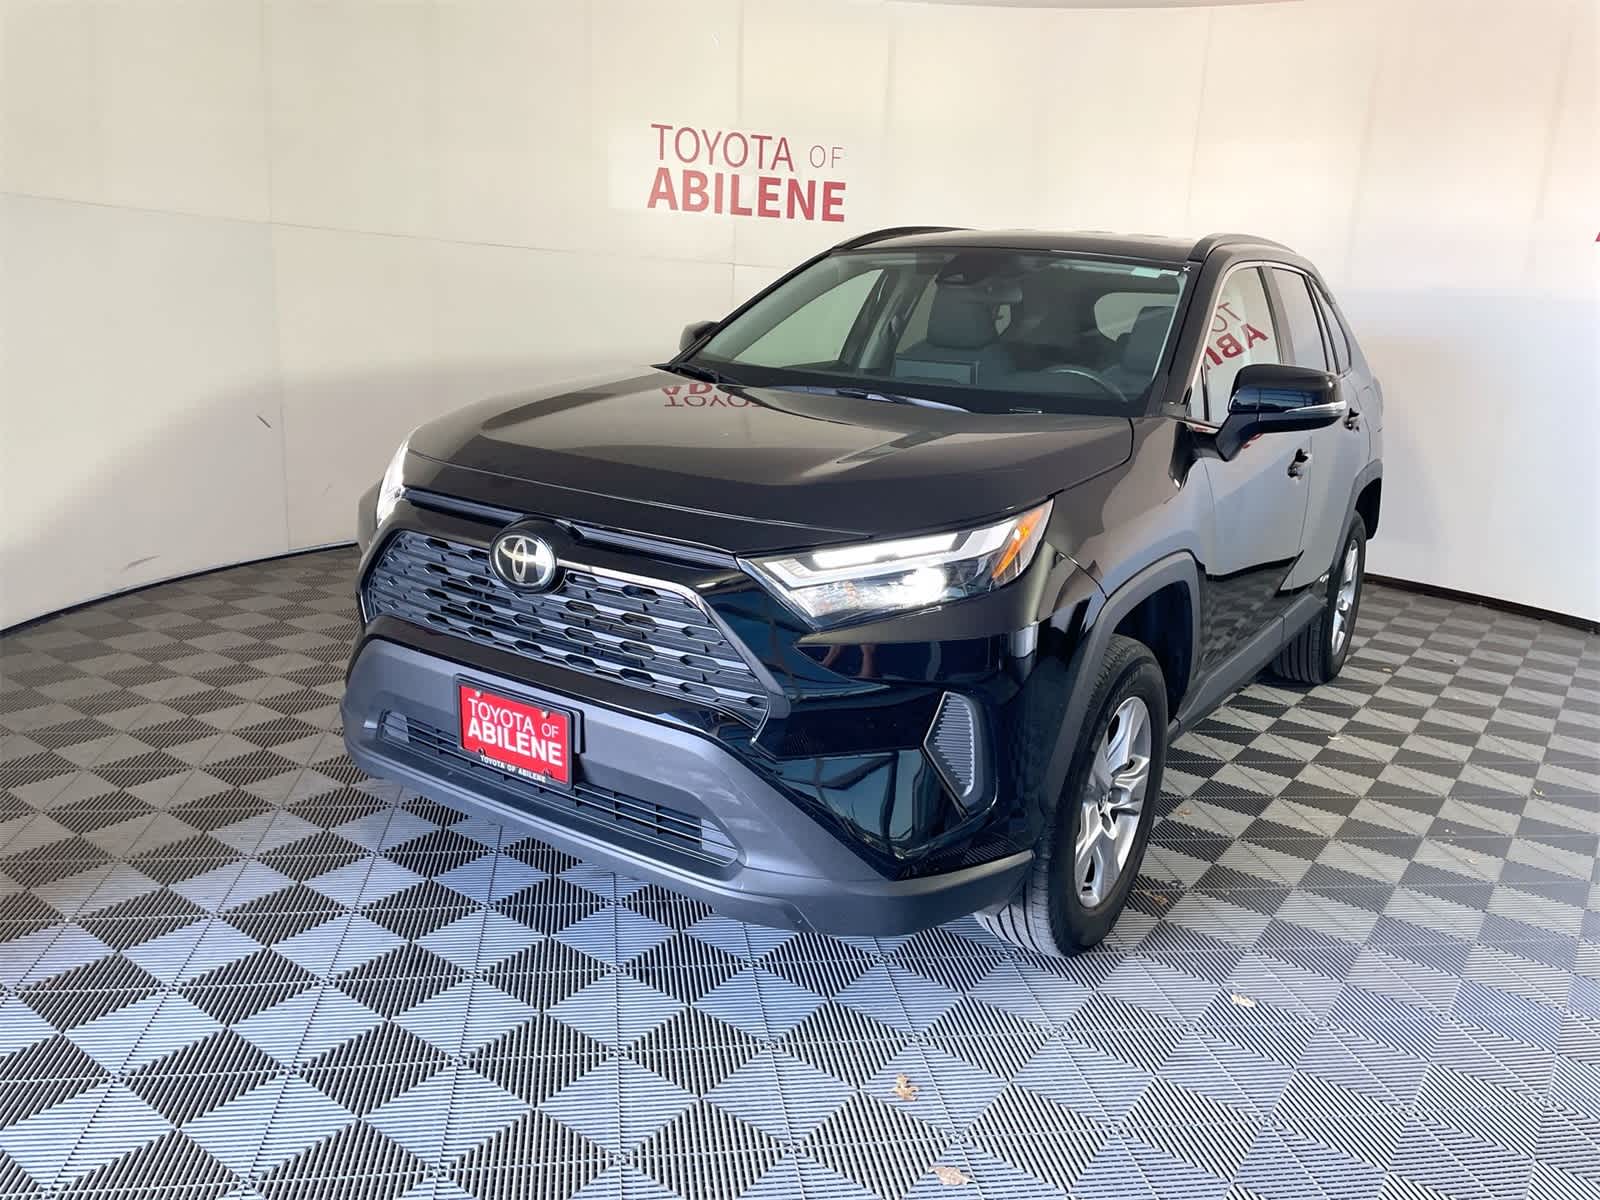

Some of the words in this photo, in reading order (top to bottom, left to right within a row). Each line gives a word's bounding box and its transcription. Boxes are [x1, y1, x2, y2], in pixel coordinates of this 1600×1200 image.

[651, 123, 794, 172] TOYOTA
[809, 145, 844, 169] OF
[647, 167, 846, 222] ABILENE
[467, 697, 535, 736] TOYOTA
[541, 722, 559, 738] OF
[467, 716, 563, 767] ABILENE
[480, 755, 505, 769] TOYOTA
[506, 764, 517, 773] OF
[518, 767, 546, 783] ABILENE
